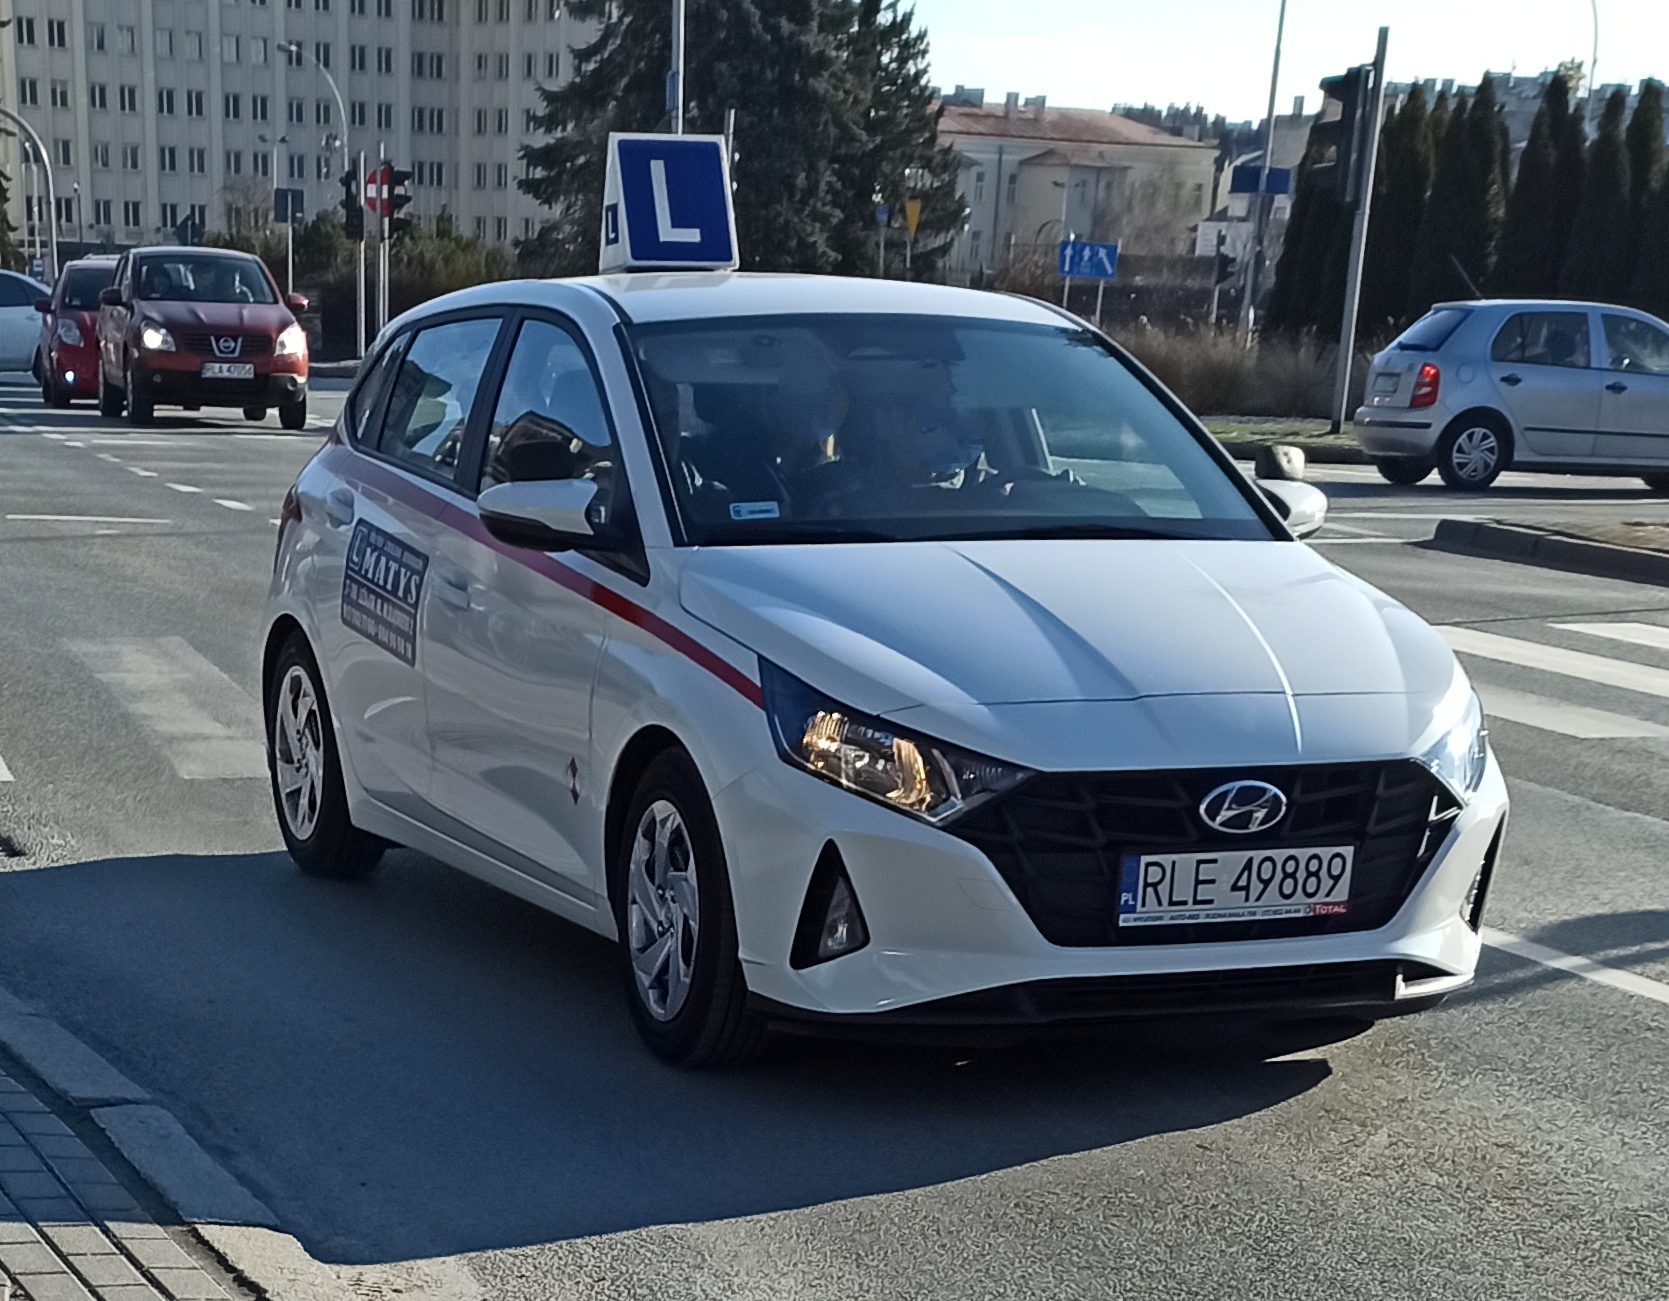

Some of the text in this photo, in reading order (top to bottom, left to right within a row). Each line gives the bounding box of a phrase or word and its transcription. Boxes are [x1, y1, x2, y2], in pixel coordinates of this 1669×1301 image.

[650, 159, 701, 243] L
[607, 210, 616, 240] L
[361, 547, 420, 604] MATYS
[1120, 892, 1135, 905] PL
[1141, 852, 1347, 908] RLE 49889
[1315, 904, 1347, 915] TOTAL
